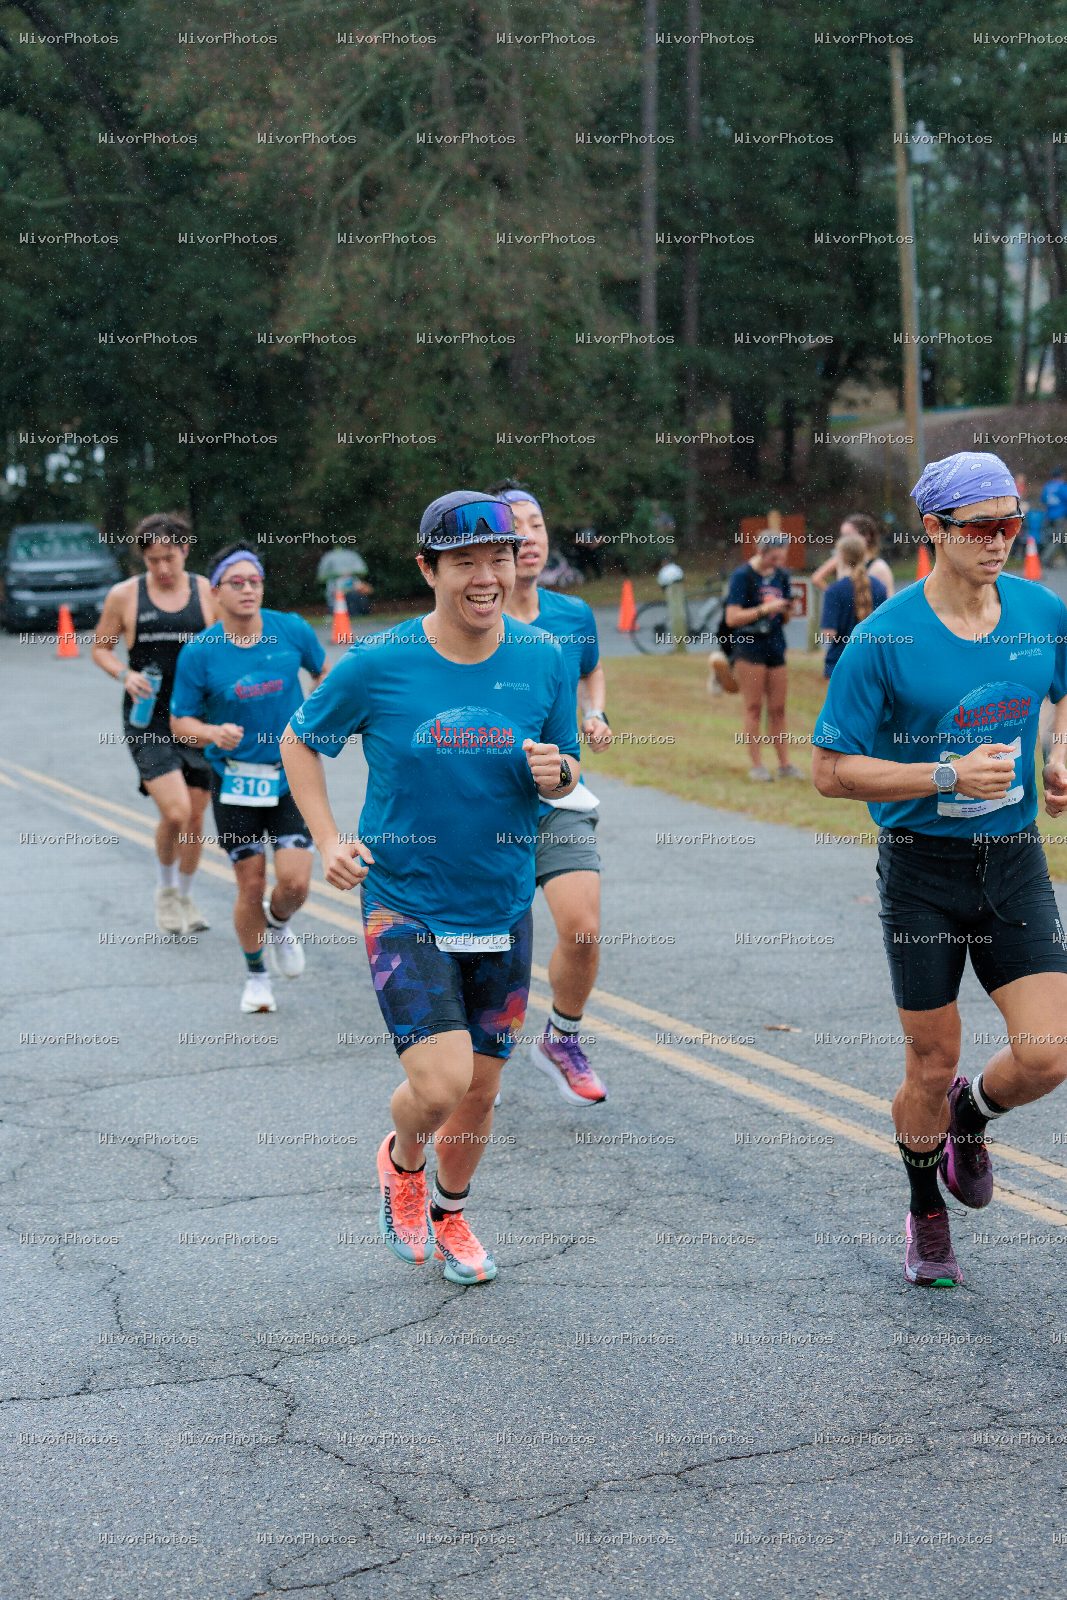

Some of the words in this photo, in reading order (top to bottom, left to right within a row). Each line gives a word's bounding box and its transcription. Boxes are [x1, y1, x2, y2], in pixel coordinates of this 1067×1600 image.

[966, 696, 1031, 719] TUCSON
[442, 727, 513, 740] TUCSON
[977, 722, 999, 734] HALF
[1003, 717, 1027, 727] RELAY
[231, 777, 271, 797] 310
